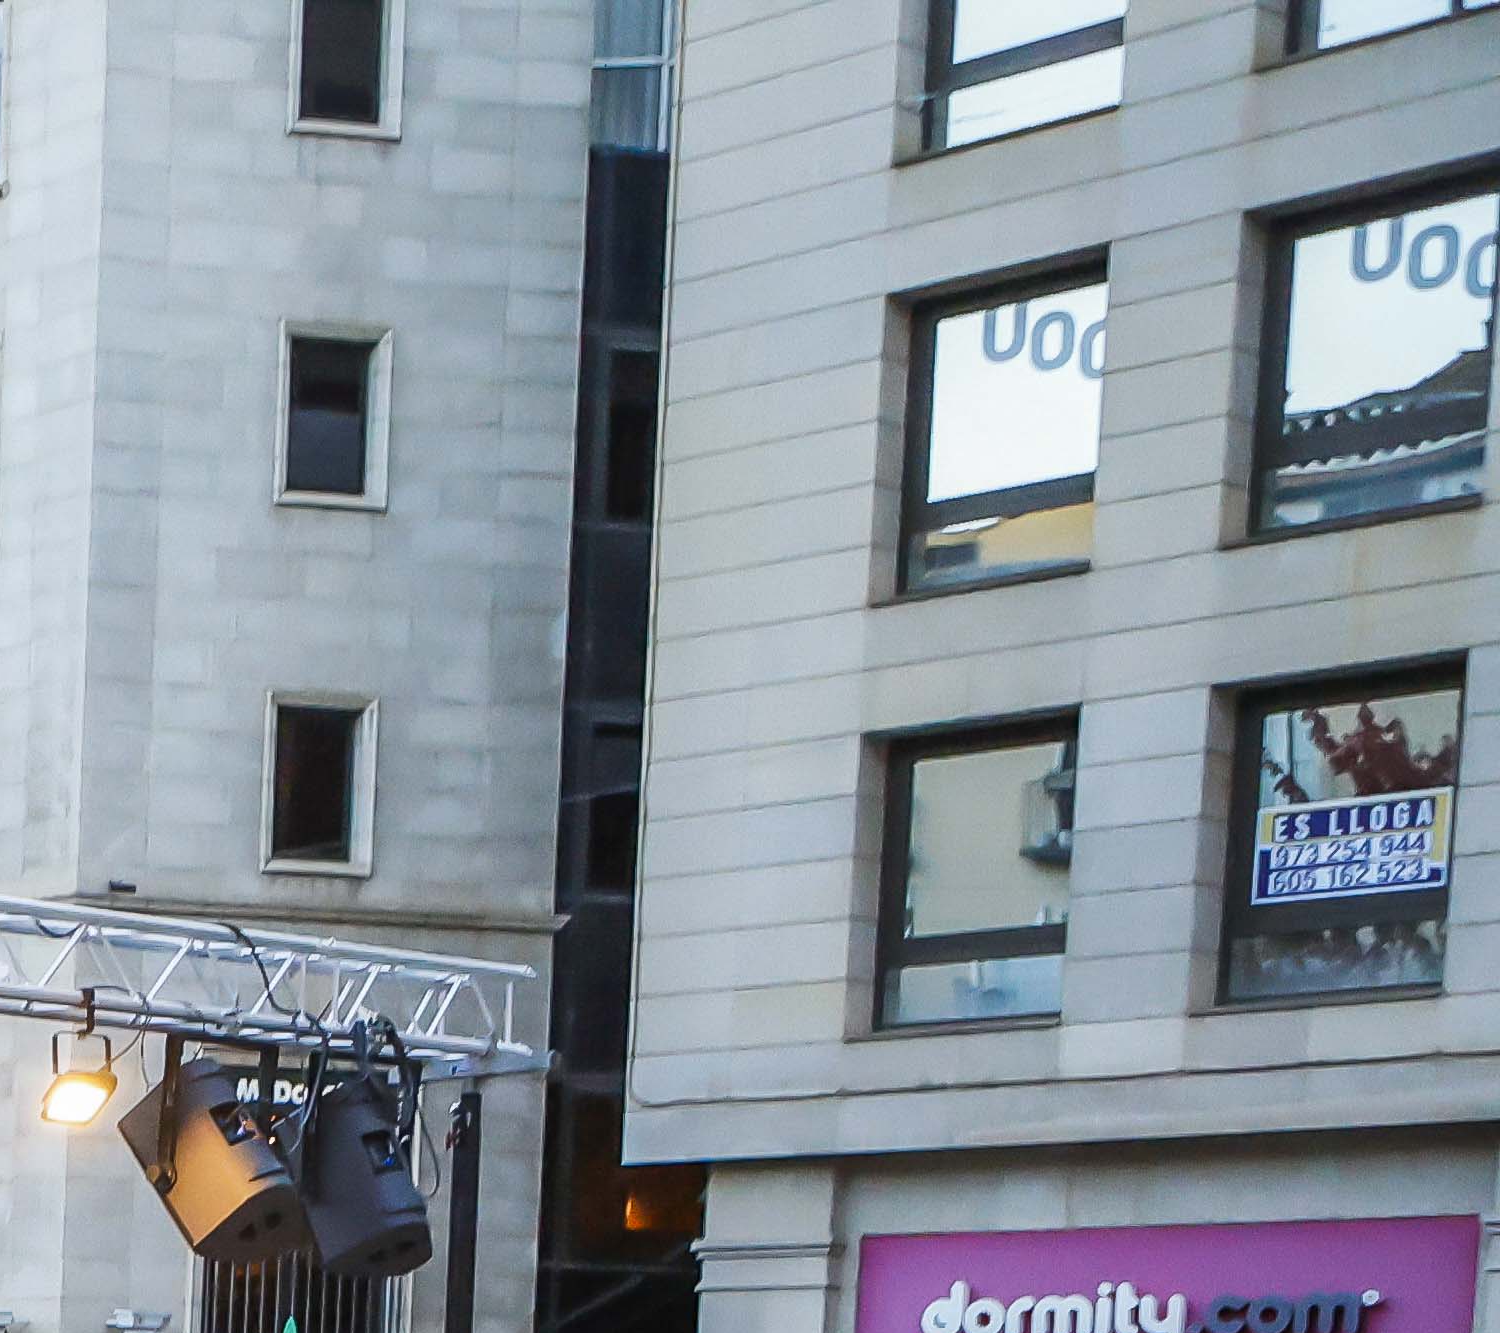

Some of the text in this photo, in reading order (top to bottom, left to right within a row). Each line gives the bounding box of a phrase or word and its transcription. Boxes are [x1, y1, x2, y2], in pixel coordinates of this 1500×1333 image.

[1274, 799, 1434, 843] ES LLOGA
[1326, 838, 1372, 864] 254
[1378, 831, 1427, 856] 944
